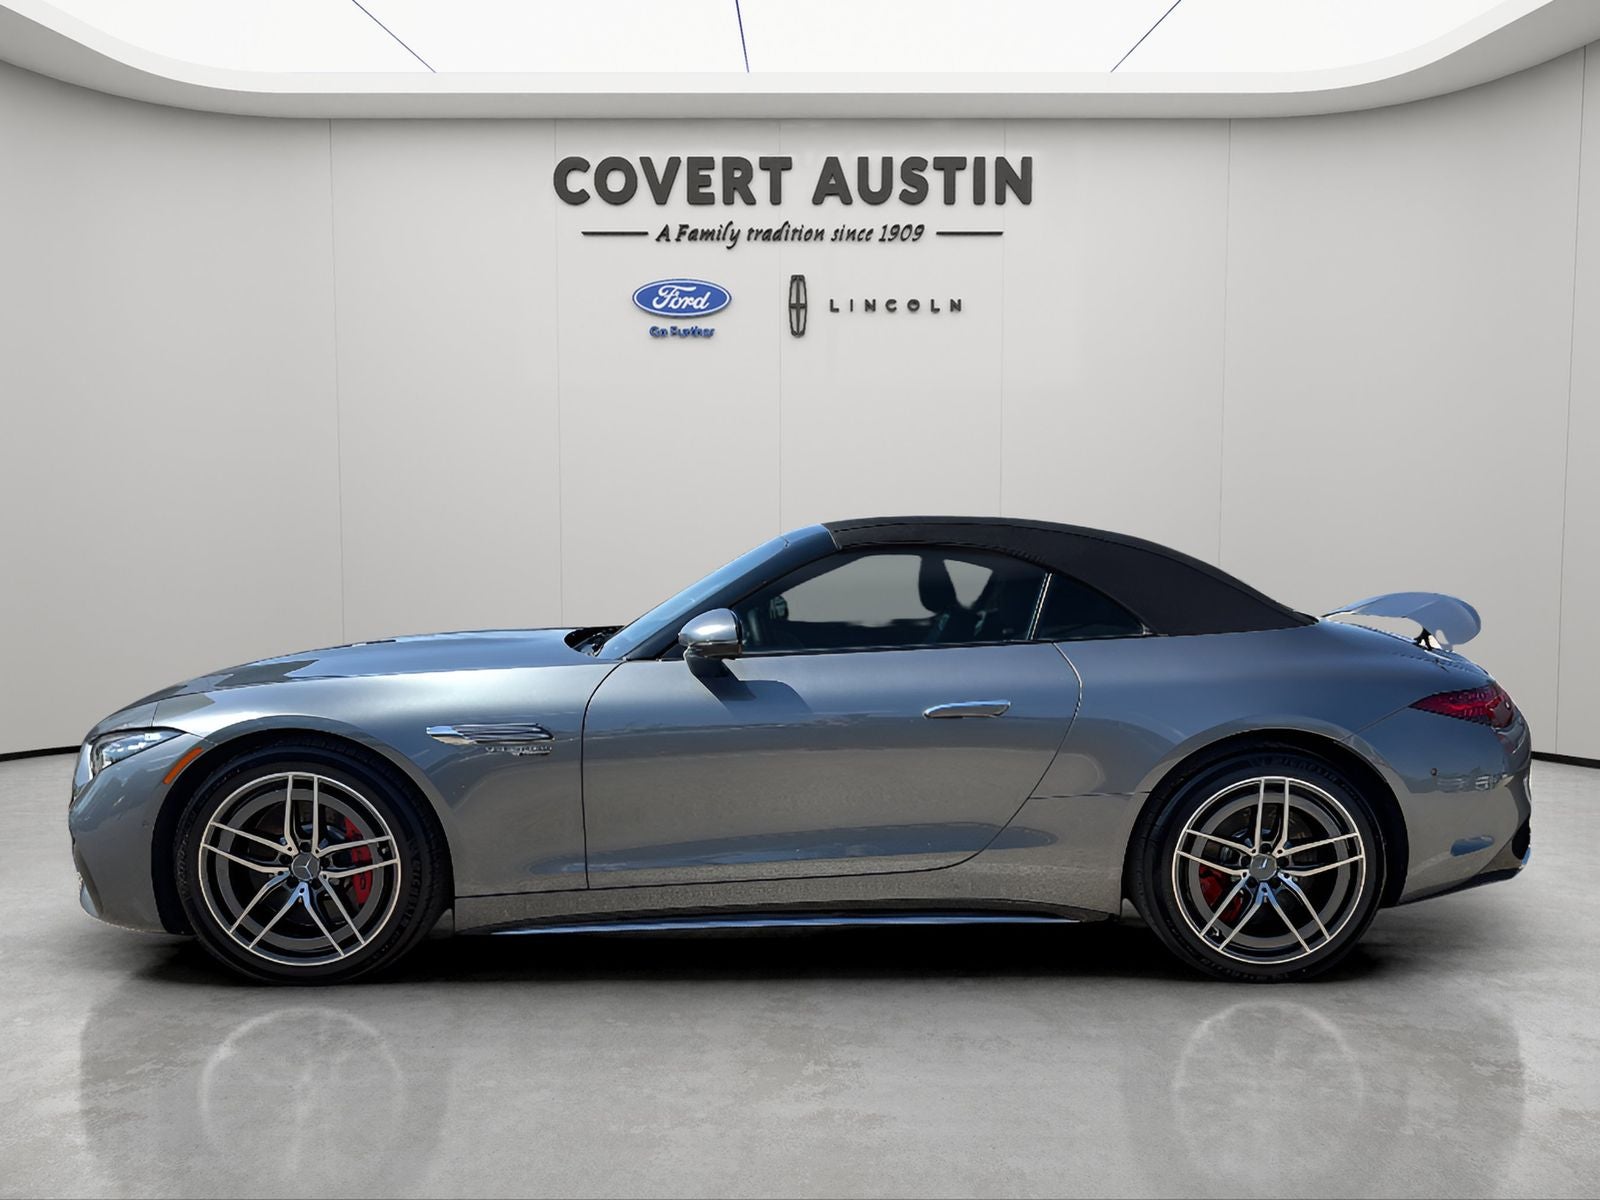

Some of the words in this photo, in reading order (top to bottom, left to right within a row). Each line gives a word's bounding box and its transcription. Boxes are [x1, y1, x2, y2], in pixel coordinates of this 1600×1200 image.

[553, 156, 793, 207] COVERT
[811, 156, 1034, 207] AUSTIN
[655, 223, 672, 243] A
[674, 220, 741, 250] Family
[746, 220, 825, 243] tradition
[830, 224, 874, 243] since
[878, 223, 926, 243] 1909
[652, 284, 712, 310] Ford
[829, 298, 963, 314] LINCOLN
